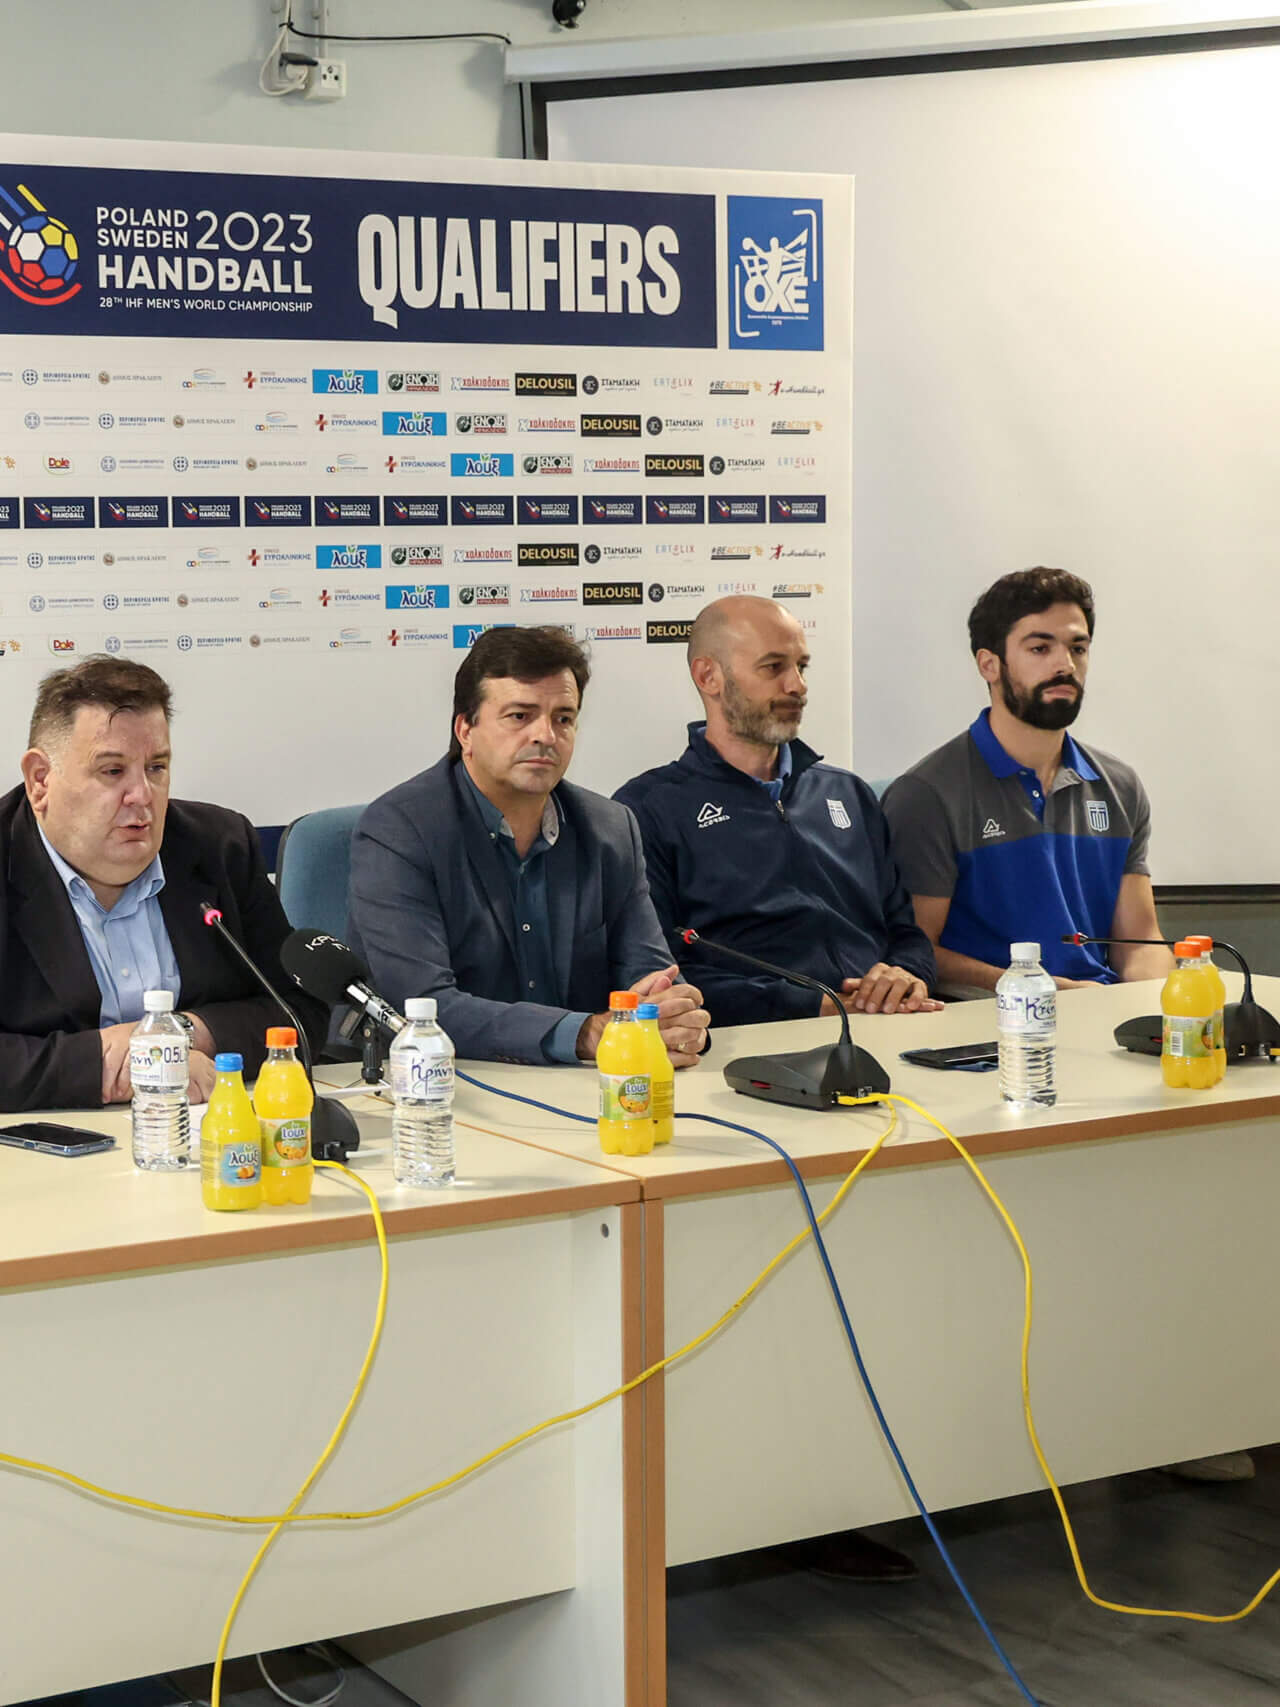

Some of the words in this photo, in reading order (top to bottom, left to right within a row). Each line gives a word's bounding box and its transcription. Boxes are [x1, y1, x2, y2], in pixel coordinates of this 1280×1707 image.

[96, 207, 189, 227] POLAND
[195, 210, 313, 254] 2023
[97, 228, 189, 249] SWEDEN
[97, 254, 313, 294] HANDBALL
[357, 213, 681, 330] QUALIFIERS
[125, 298, 143, 308] IHF
[146, 298, 181, 309] MEN'S
[183, 299, 226, 311] WORLD
[228, 300, 313, 313] CHAMPIONSHIP
[517, 377, 575, 390] DELOUSIL
[583, 418, 640, 431] DELOUSIL
[48, 457, 70, 467] Dole
[646, 458, 703, 471] DELOUSIL
[520, 548, 577, 561] DELOUSIL
[585, 586, 641, 599] DELOUSIL
[648, 625, 694, 638] DELOUS
[53, 639, 75, 650] Dole
